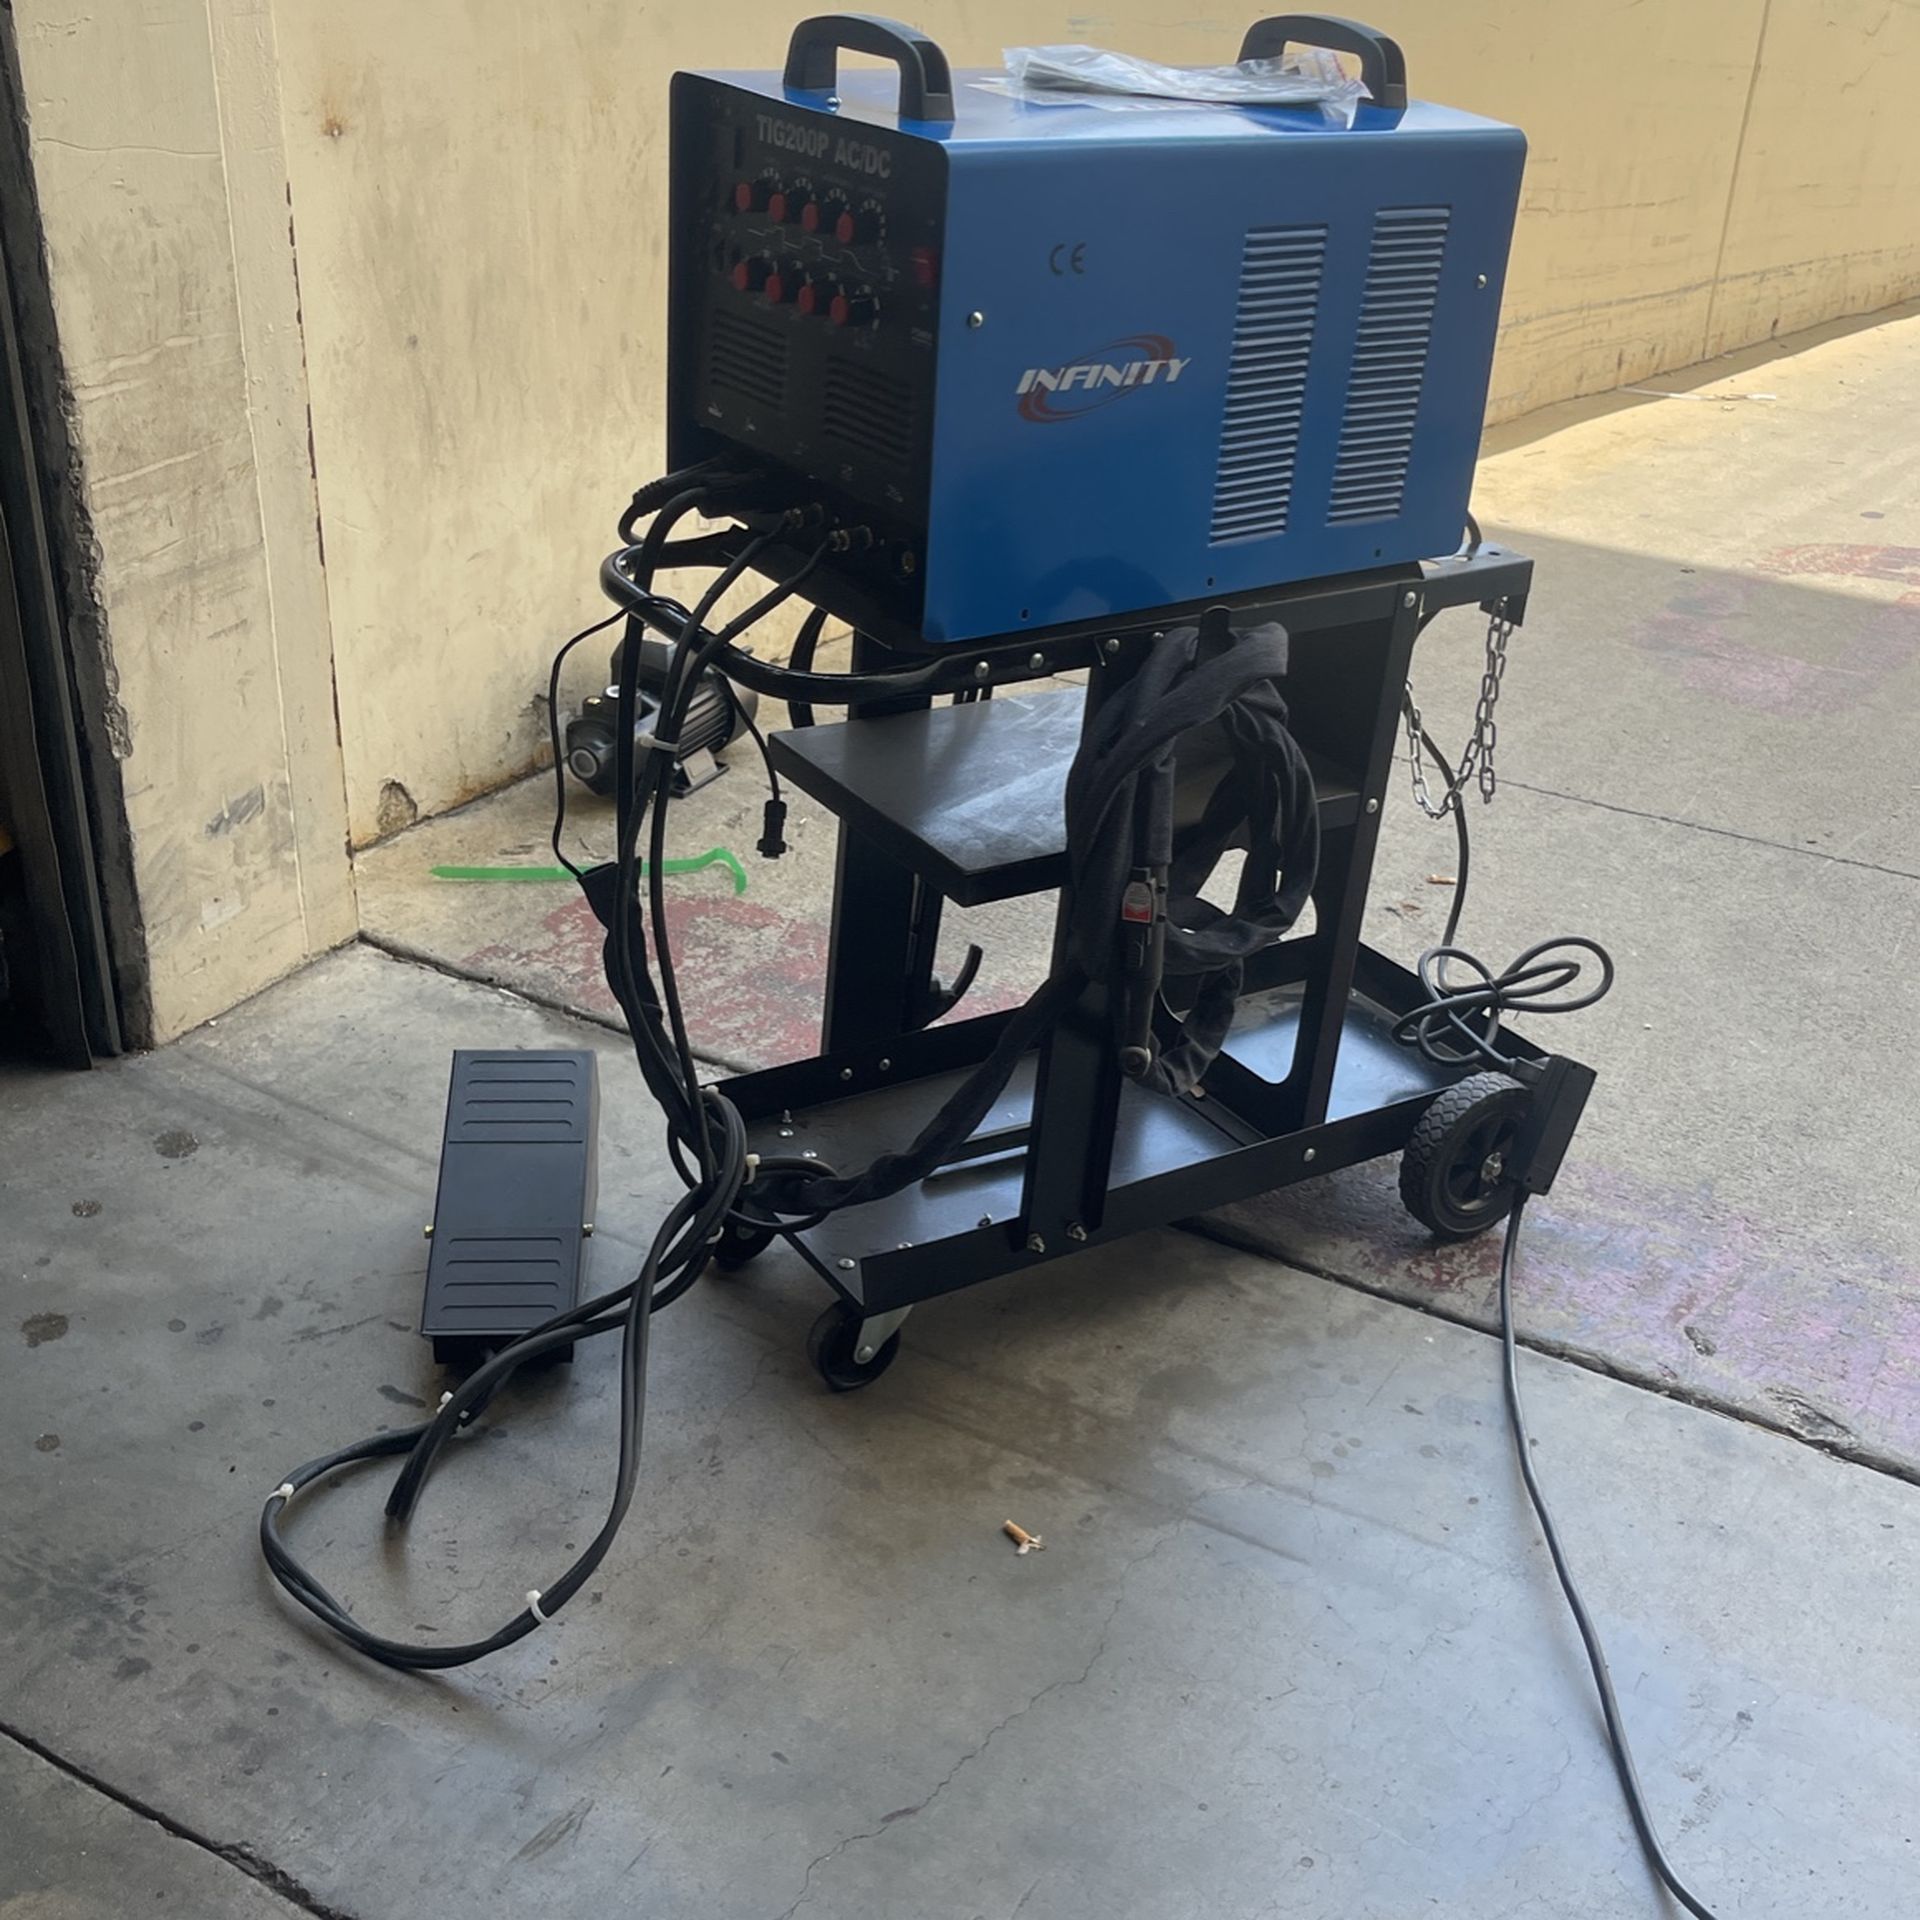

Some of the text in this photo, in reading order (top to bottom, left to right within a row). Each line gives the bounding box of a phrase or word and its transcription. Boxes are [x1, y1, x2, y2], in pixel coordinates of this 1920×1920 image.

[757, 114, 892, 178] TIG200P AC/DC
[1050, 242, 1087, 275] CE
[1016, 358, 1192, 394] INFINITY
